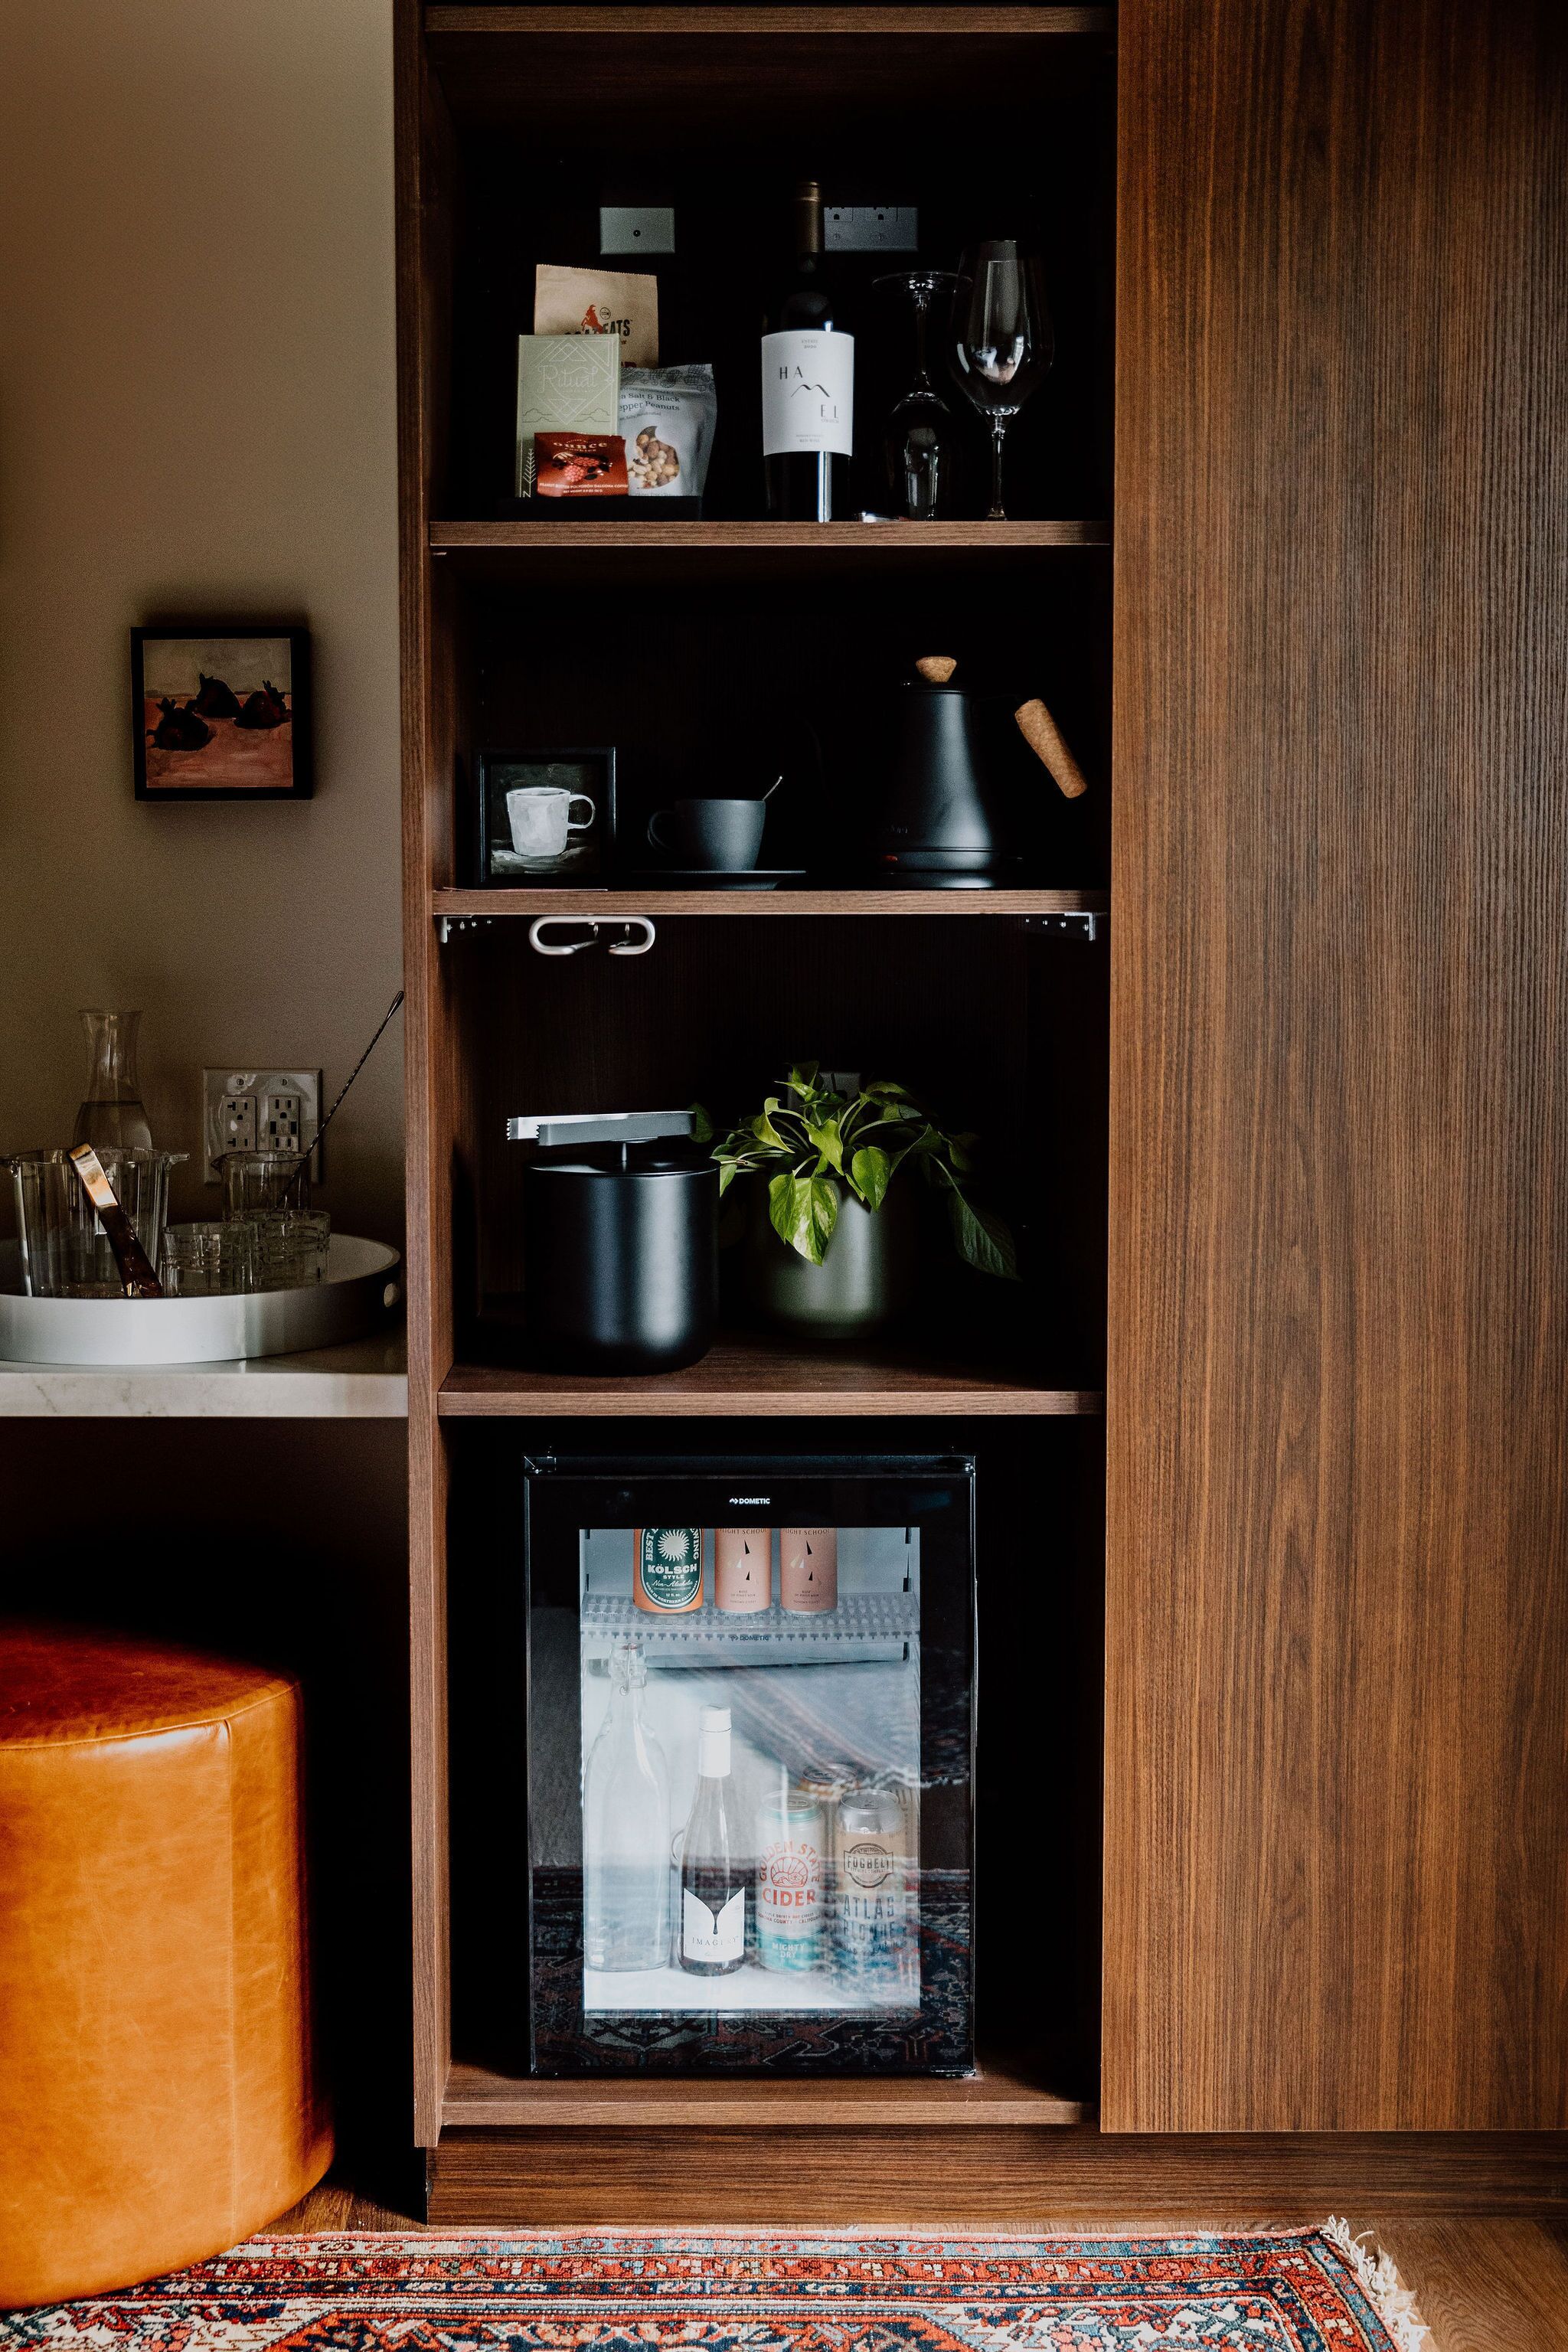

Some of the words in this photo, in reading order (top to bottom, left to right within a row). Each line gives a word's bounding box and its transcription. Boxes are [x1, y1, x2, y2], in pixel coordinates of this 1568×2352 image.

[619, 402, 644, 413] epper
[645, 400, 680, 411] Peanuts
[657, 394, 681, 403] Black
[645, 1532, 655, 1561] BEST
[647, 1563, 697, 1575] KÖLSCH
[759, 1841, 793, 1882] GOLDEN
[799, 1844, 822, 1883] STATE
[762, 1887, 816, 1907] CIDER
[844, 1894, 894, 1919] ATLAS
[772, 1942, 805, 1952] MIGHTY
